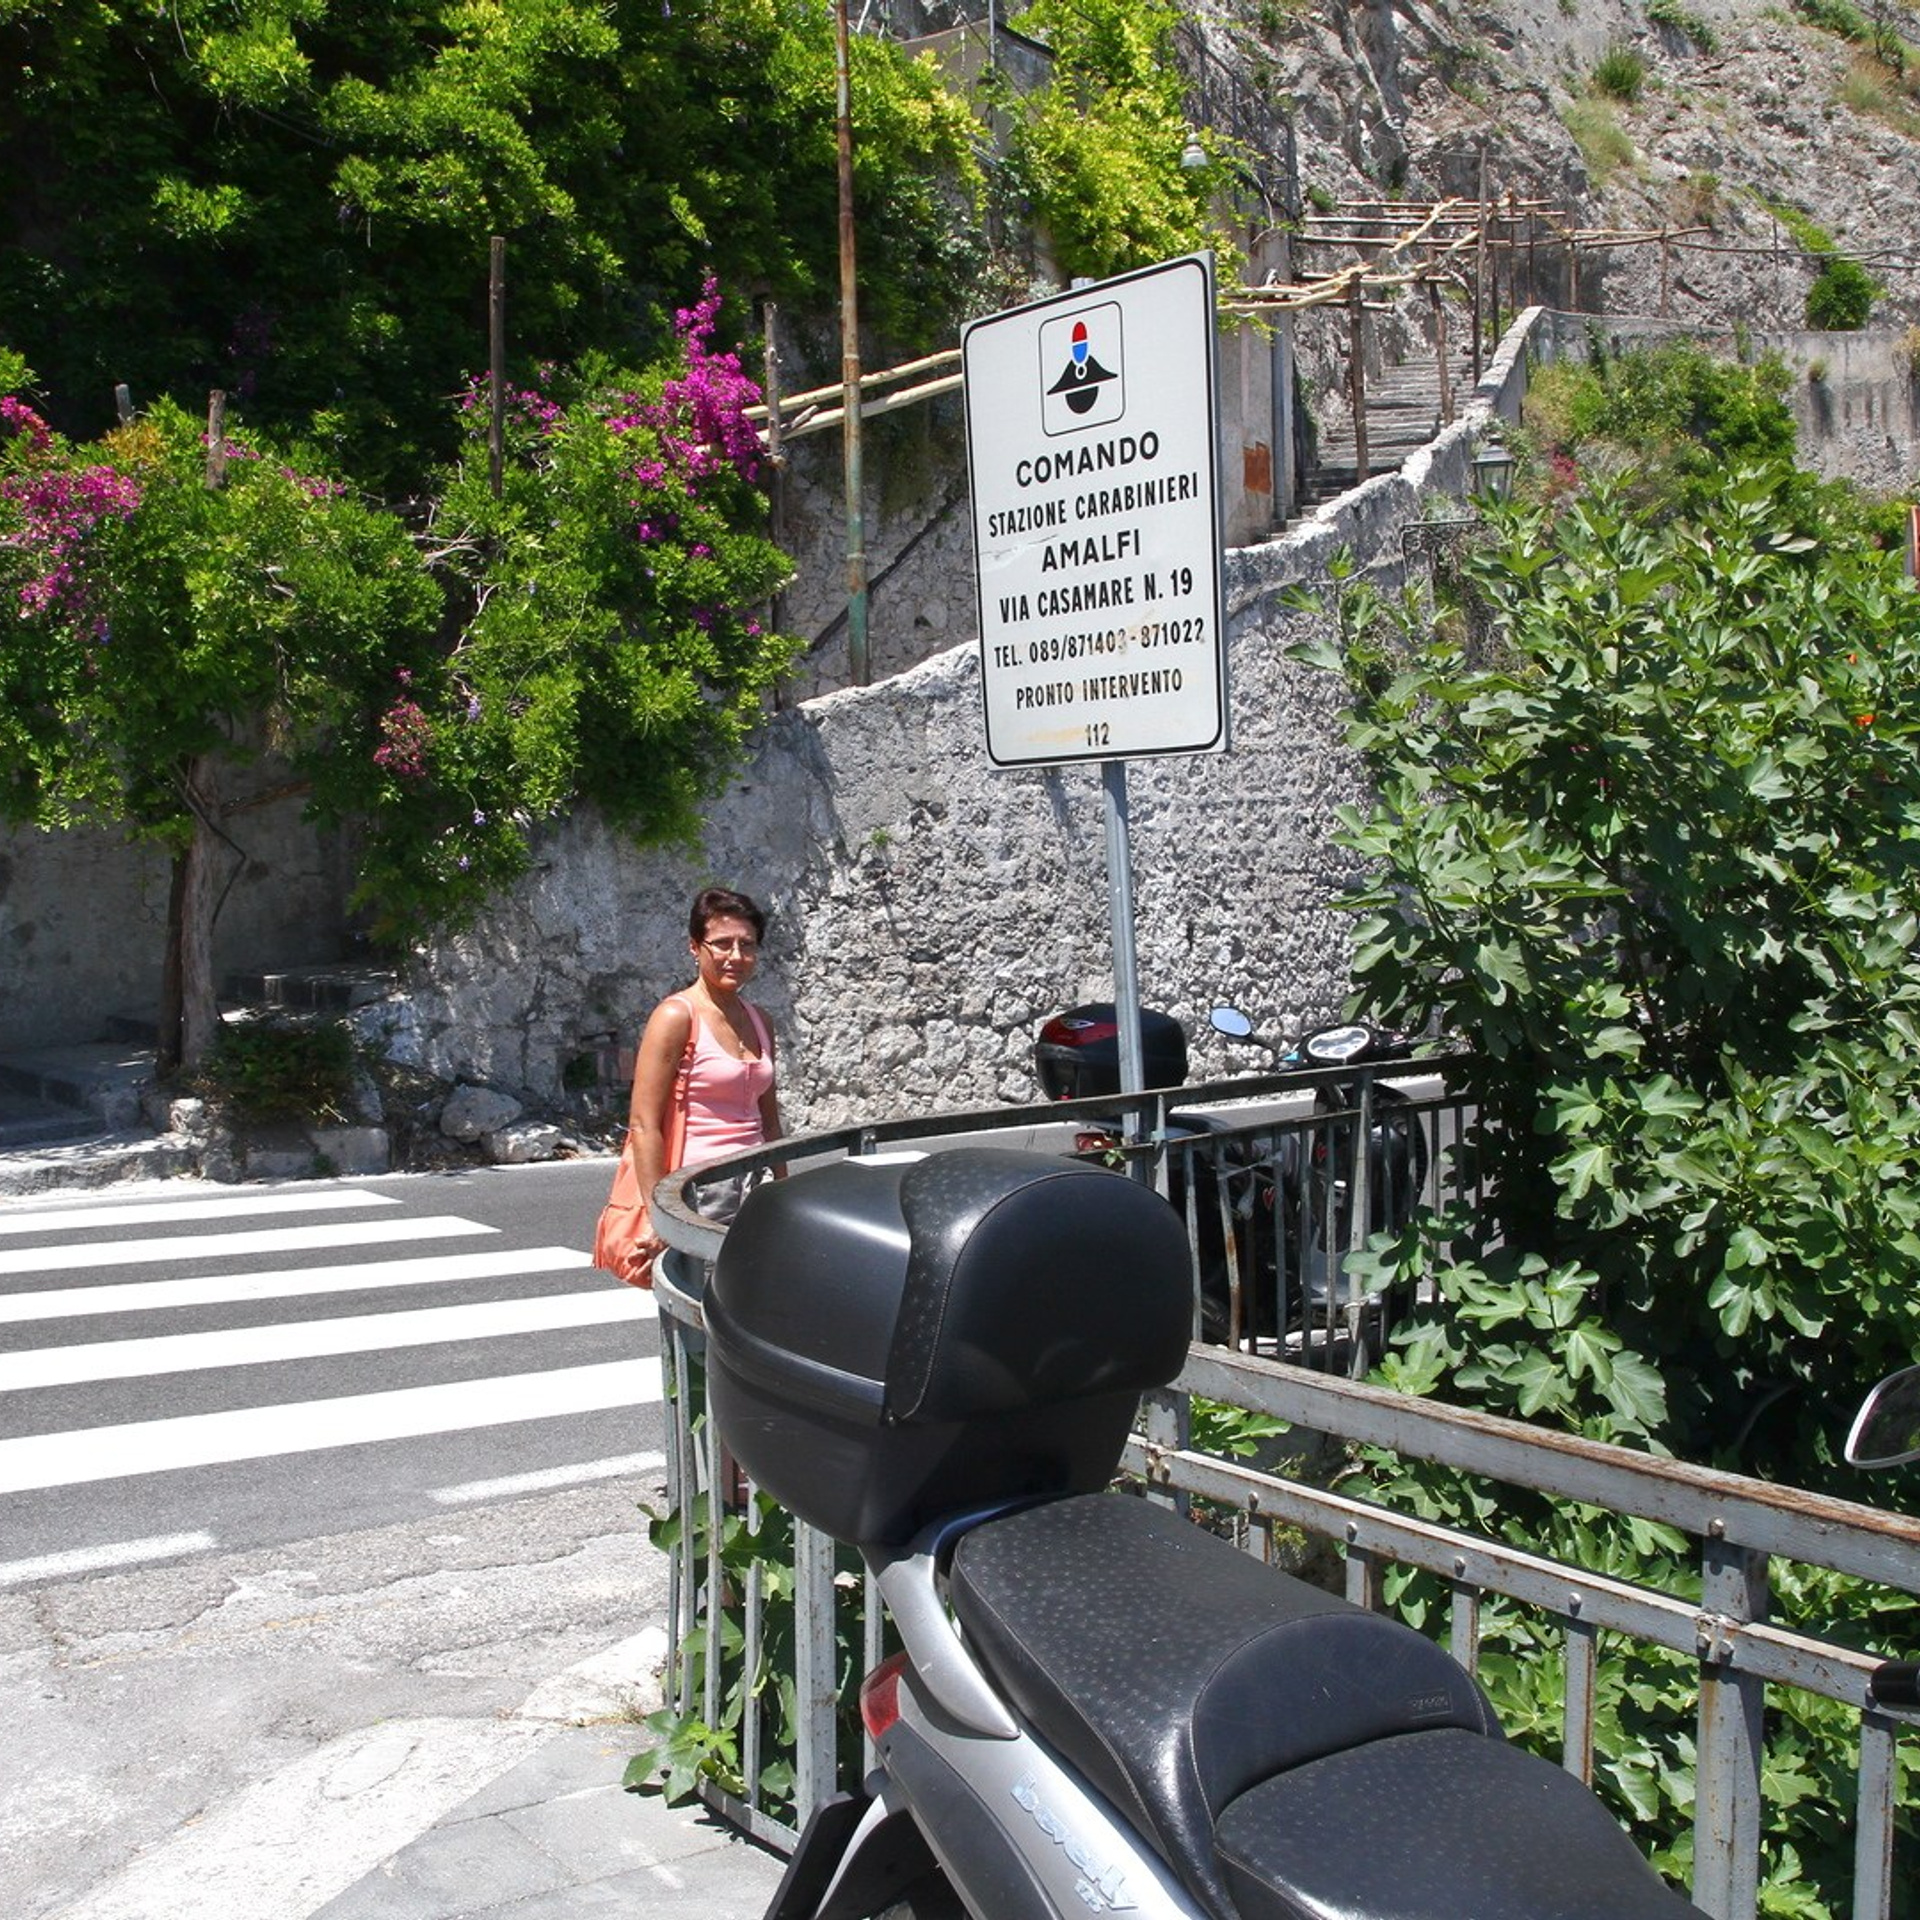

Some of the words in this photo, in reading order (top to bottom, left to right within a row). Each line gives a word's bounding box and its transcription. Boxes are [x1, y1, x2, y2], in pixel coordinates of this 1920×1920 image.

[1017, 431, 1159, 487] COMANDO
[989, 499, 1067, 537] STAZIONE
[1076, 472, 1198, 520] CARABINIERI
[1042, 529, 1140, 572] AMALFI
[1000, 594, 1030, 623] VIA
[1038, 576, 1134, 617] CASAMARE
[1144, 572, 1164, 601] N.
[1170, 567, 1193, 597] 19
[994, 643, 1023, 669] TEL.
[1016, 681, 1074, 710] PRONTO
[1083, 668, 1182, 701] INTERVENTO
[1084, 722, 1110, 747] 112
